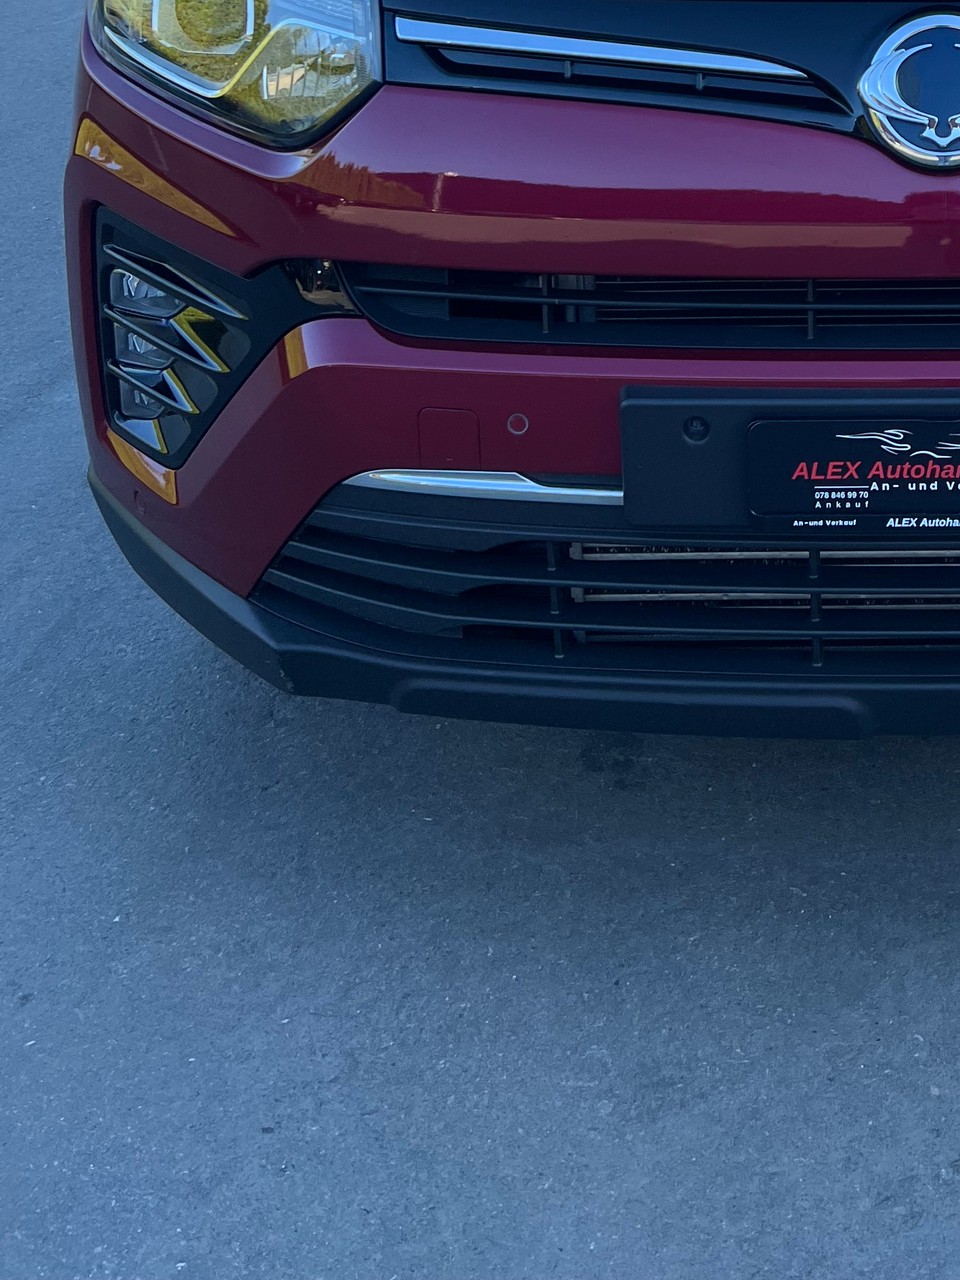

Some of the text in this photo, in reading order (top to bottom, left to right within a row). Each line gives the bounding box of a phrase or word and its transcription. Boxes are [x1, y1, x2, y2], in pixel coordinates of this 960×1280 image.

[791, 461, 862, 480] ALEX
[870, 481, 899, 491] An-
[908, 481, 938, 491] und
[814, 491, 829, 499] 078
[859, 491, 869, 499] 70
[814, 500, 869, 509] Ankauf
[825, 519, 857, 527] Verkauf
[886, 518, 918, 527] ALEX
